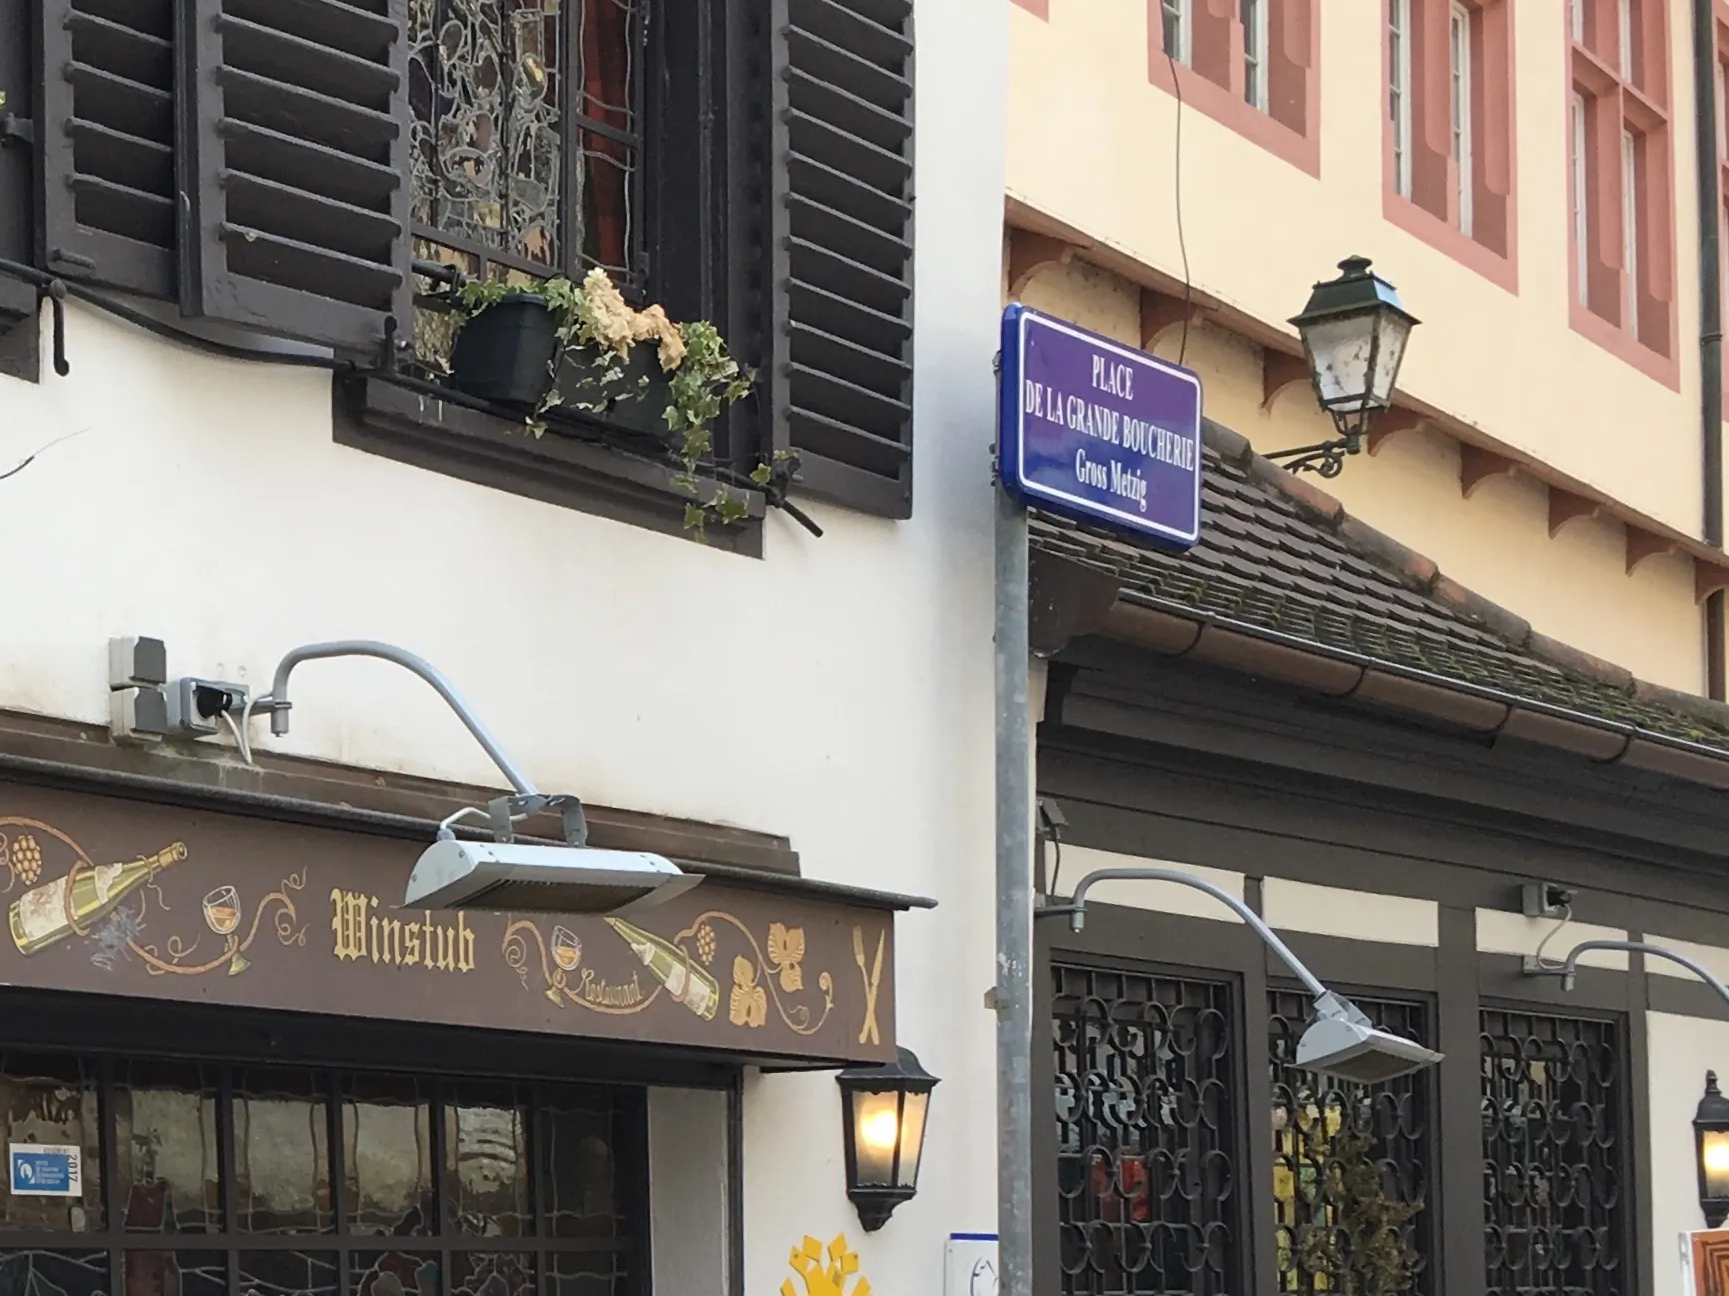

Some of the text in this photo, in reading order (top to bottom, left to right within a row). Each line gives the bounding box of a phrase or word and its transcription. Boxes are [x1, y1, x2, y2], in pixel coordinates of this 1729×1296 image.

[1092, 354, 1134, 400] PLACE
[1025, 379, 1195, 471] DE LA GRANDE BOUCHERIE
[1075, 448, 1148, 512] Gross Metzig
[329, 887, 476, 973] Winstub
[574, 967, 644, 1007] Restaurant
[67, 1153, 79, 1183] 2017
